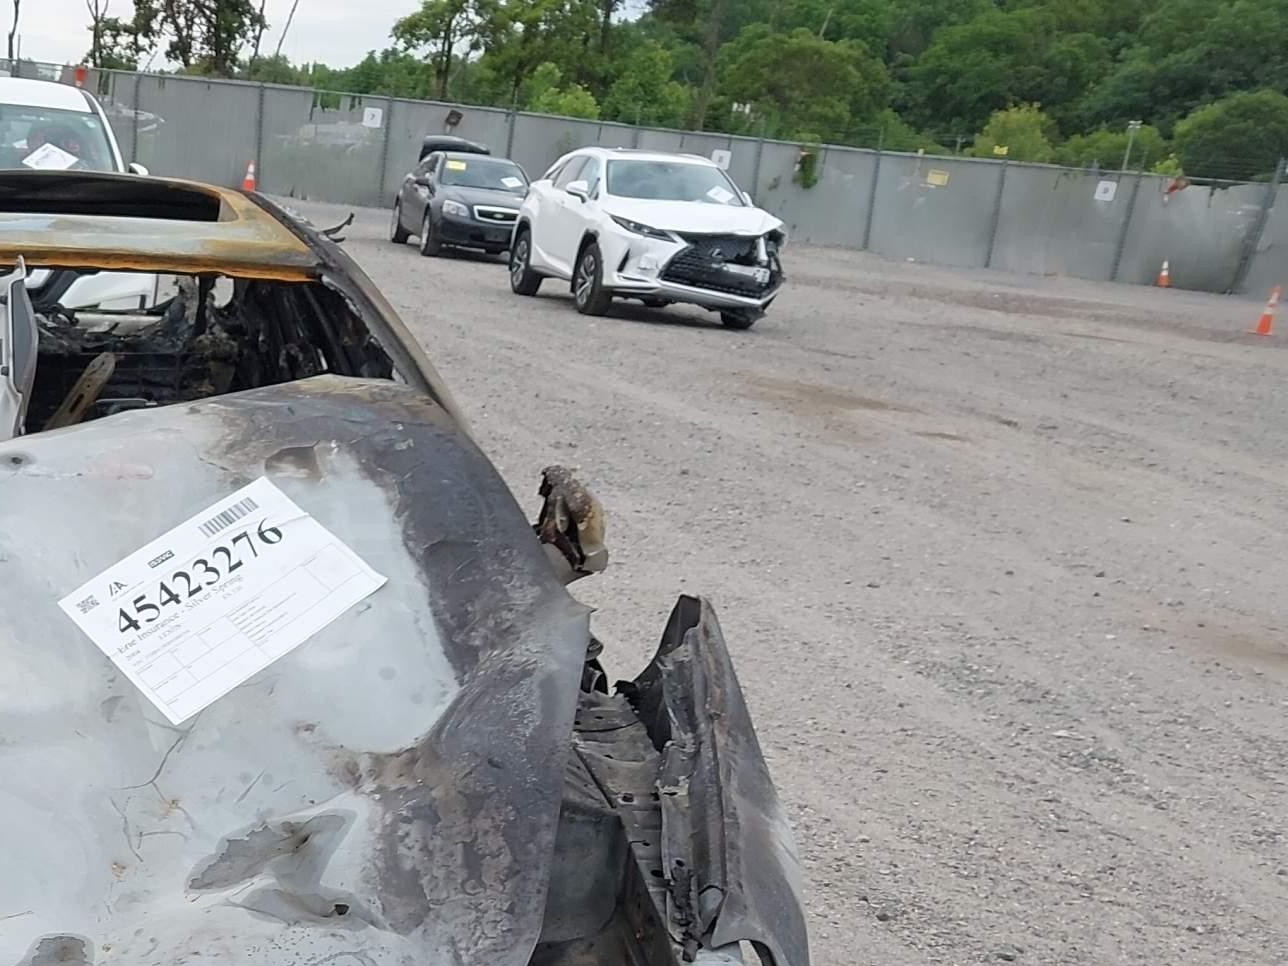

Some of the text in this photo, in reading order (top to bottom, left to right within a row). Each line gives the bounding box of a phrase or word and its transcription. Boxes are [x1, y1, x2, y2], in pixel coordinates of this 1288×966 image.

[118, 517, 283, 633] 45423276
[136, 612, 180, 641] Insurance
[184, 592, 212, 609] Silver
